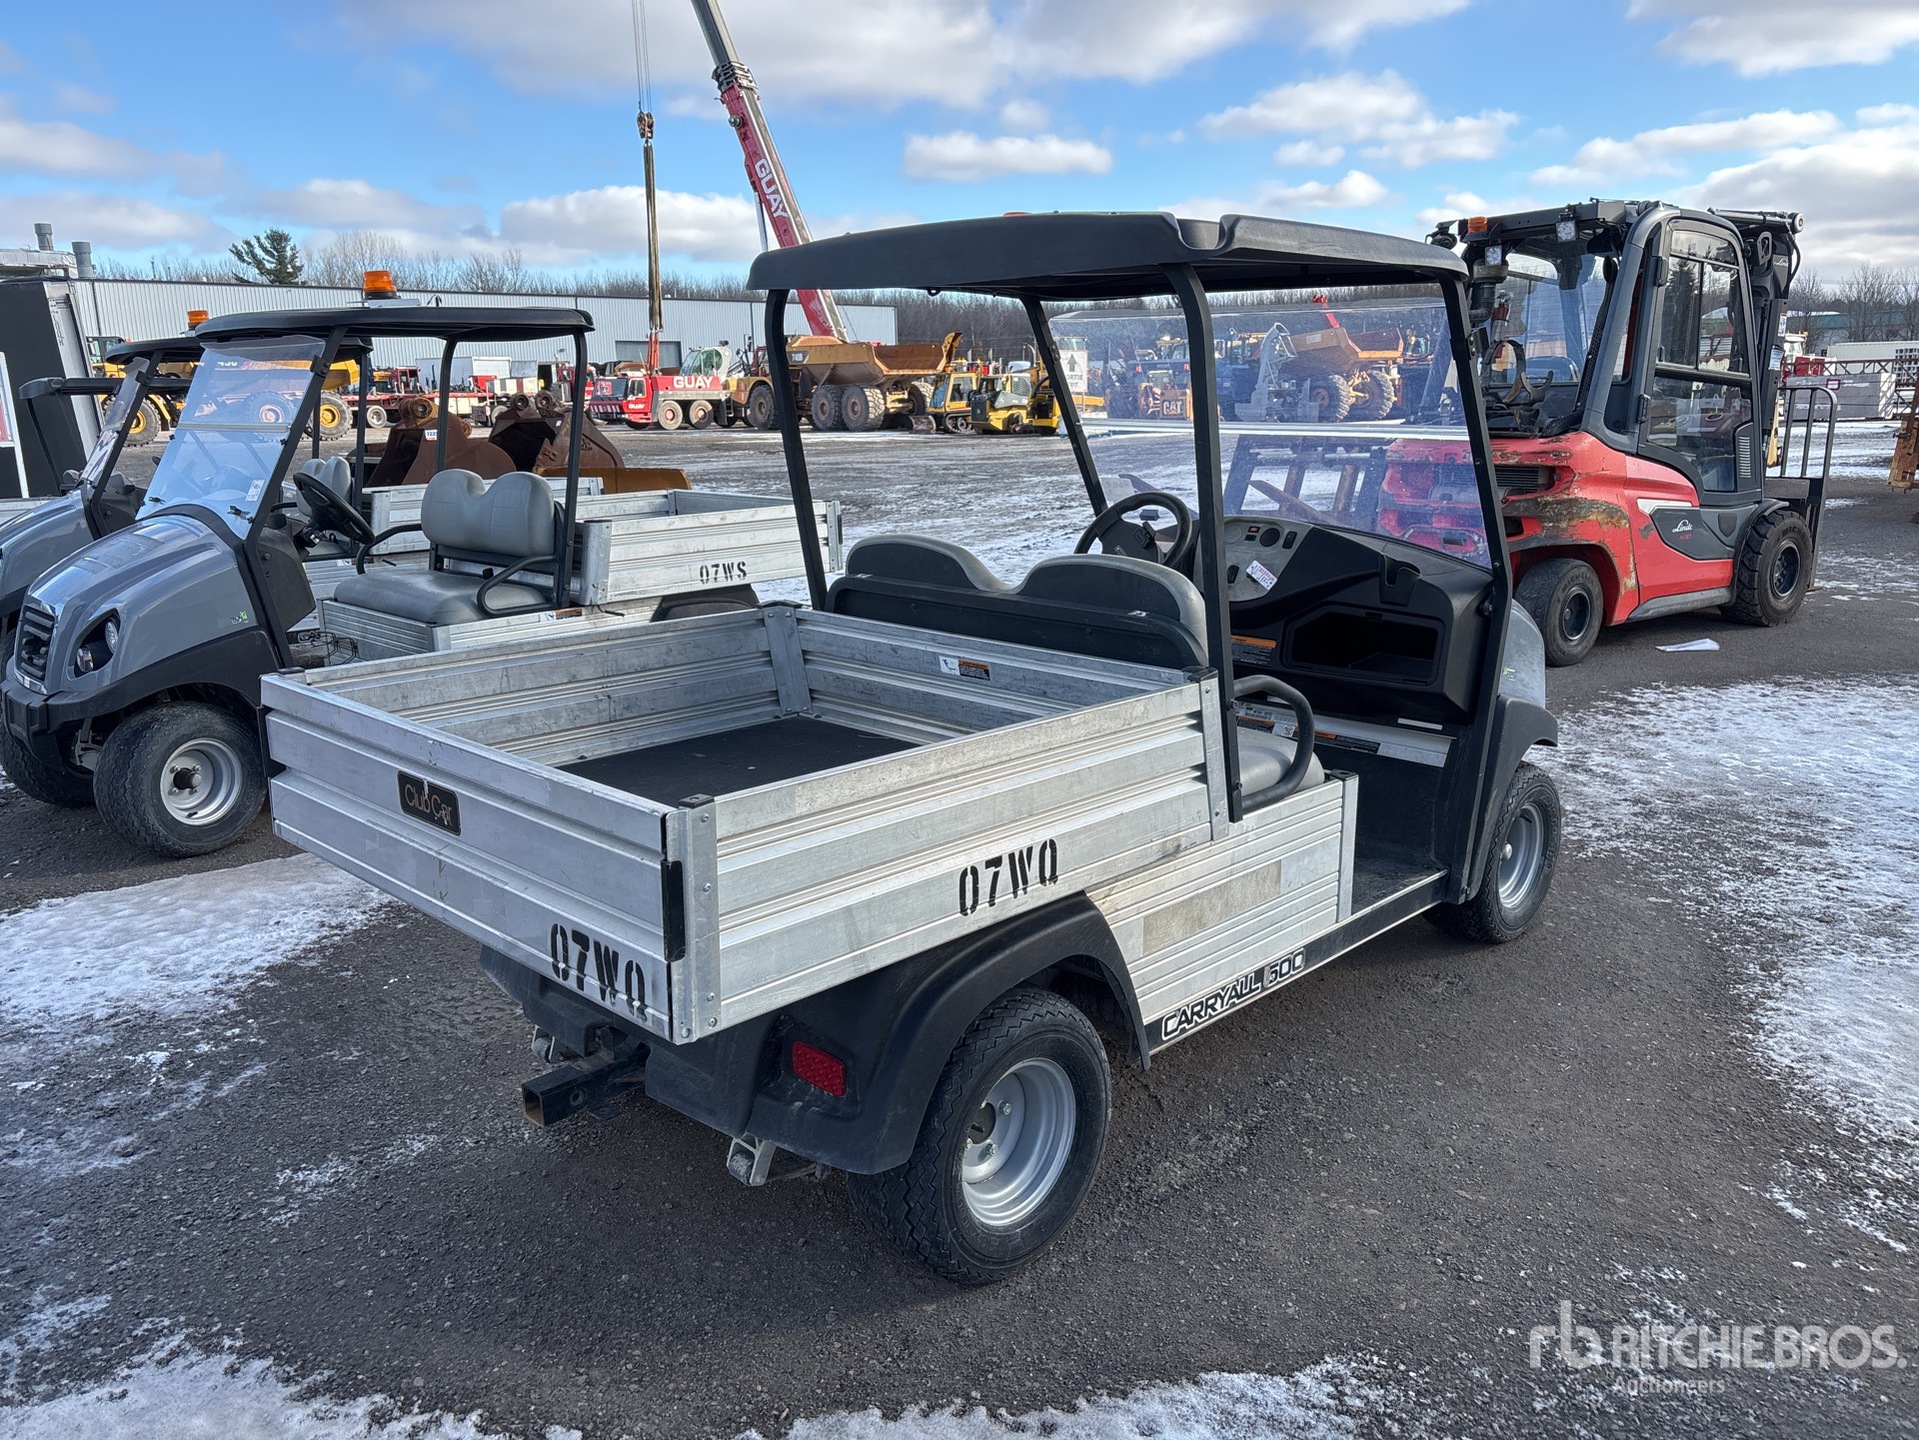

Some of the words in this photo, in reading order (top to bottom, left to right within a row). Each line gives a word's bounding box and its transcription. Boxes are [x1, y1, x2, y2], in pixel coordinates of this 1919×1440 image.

[755, 158, 788, 217] GUAY
[673, 376, 714, 388] GUAY
[1163, 401, 1182, 415] CAT
[1672, 519, 1694, 533] Linde
[699, 560, 748, 584] 07WS
[404, 784, 431, 813] Club
[432, 794, 452, 825] Car
[1162, 972, 1261, 1041] CARRYALL
[1264, 948, 1306, 988] 500
